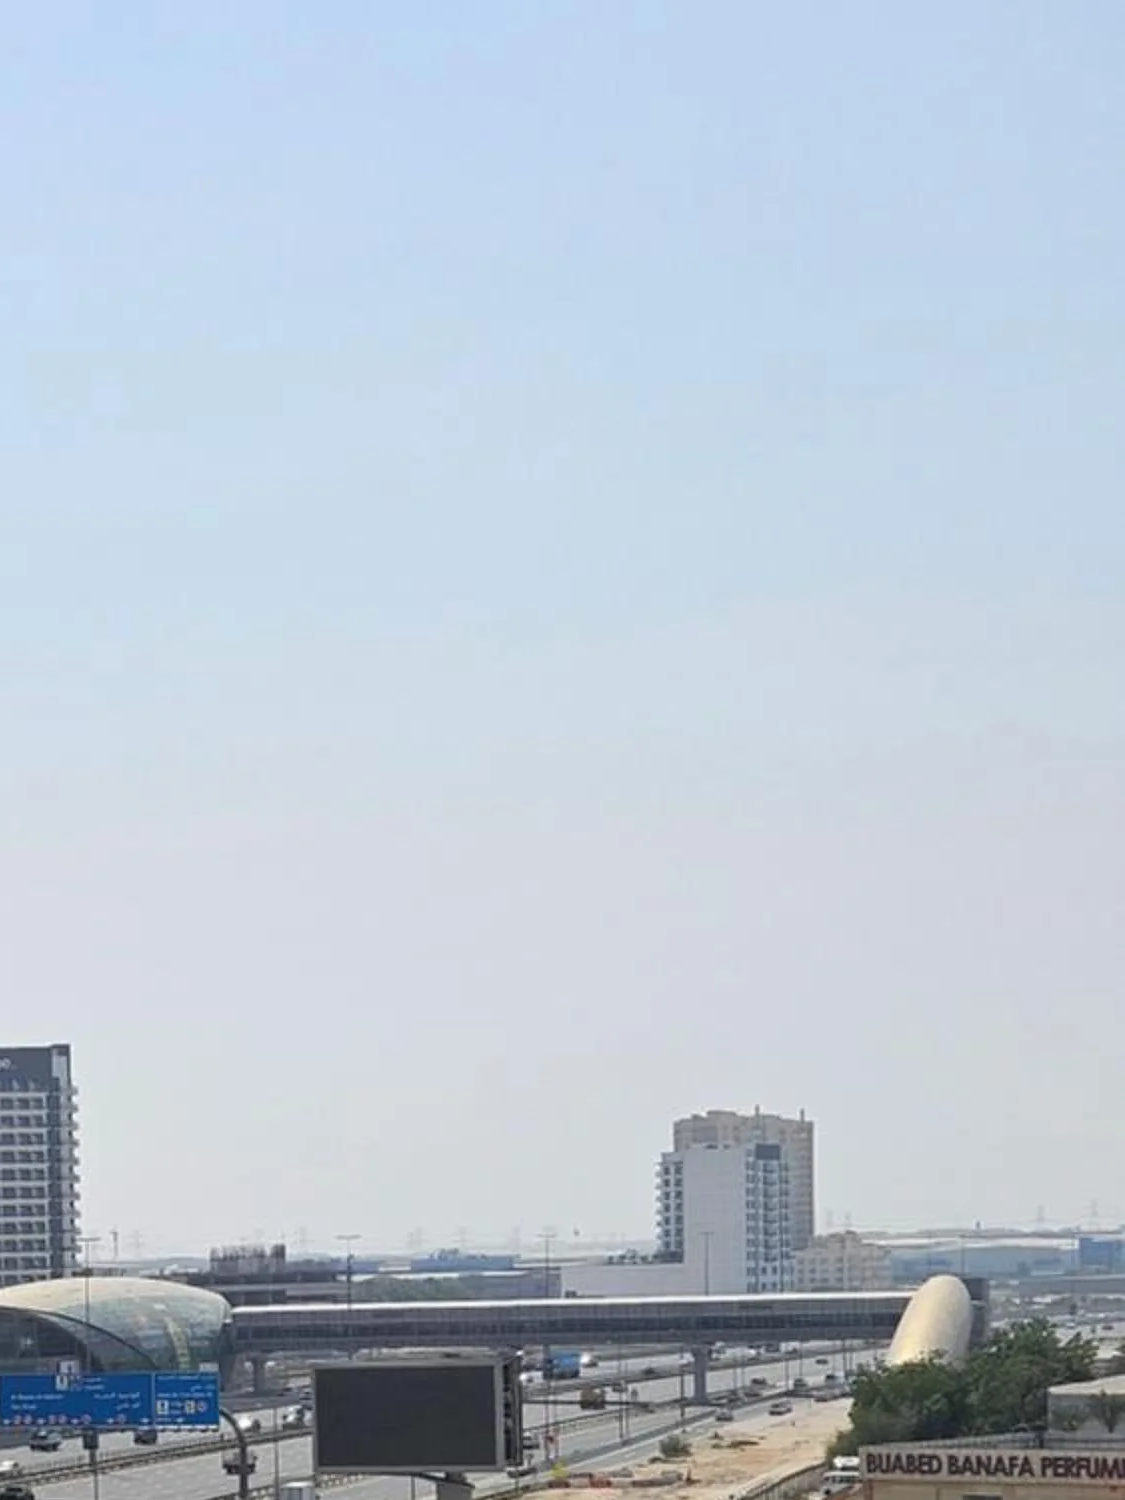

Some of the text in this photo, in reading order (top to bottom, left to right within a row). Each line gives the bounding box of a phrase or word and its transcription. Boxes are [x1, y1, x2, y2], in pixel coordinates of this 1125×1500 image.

[866, 1453, 1125, 1479] BUABED BANAFA PERFUM
